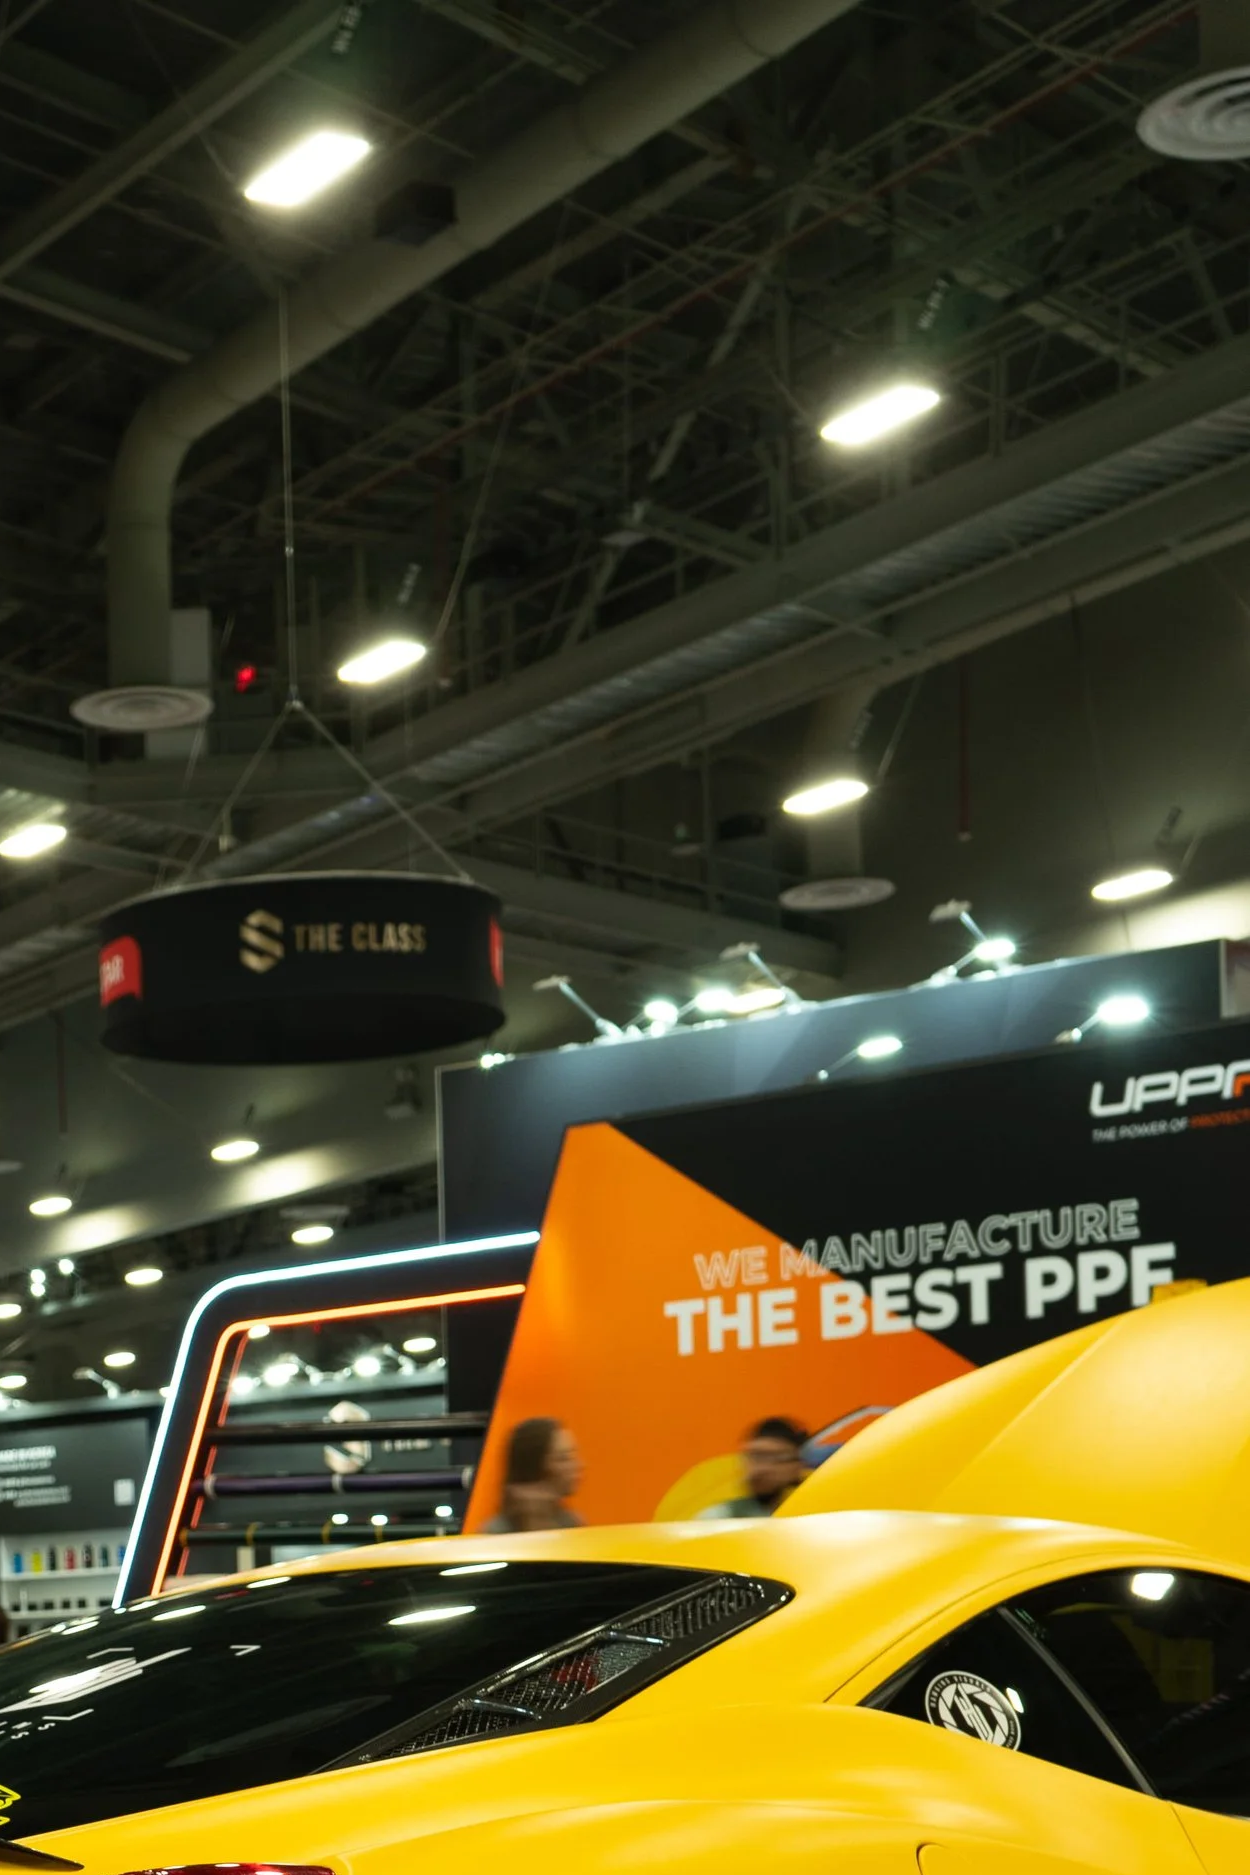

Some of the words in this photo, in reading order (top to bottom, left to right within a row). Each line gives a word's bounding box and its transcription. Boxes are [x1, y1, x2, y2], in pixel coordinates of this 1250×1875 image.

[294, 923, 344, 953] THE
[352, 922, 427, 953] CLASS
[1092, 1125, 1117, 1143] THE
[1118, 1118, 1168, 1139] POWER
[1170, 1116, 1188, 1134] OF
[693, 1245, 769, 1290] WE
[779, 1197, 1142, 1281] MANUFACTURE
[663, 1286, 800, 1356] THE
[819, 1261, 1004, 1341] BEST
[1024, 1241, 1177, 1319] PPF
